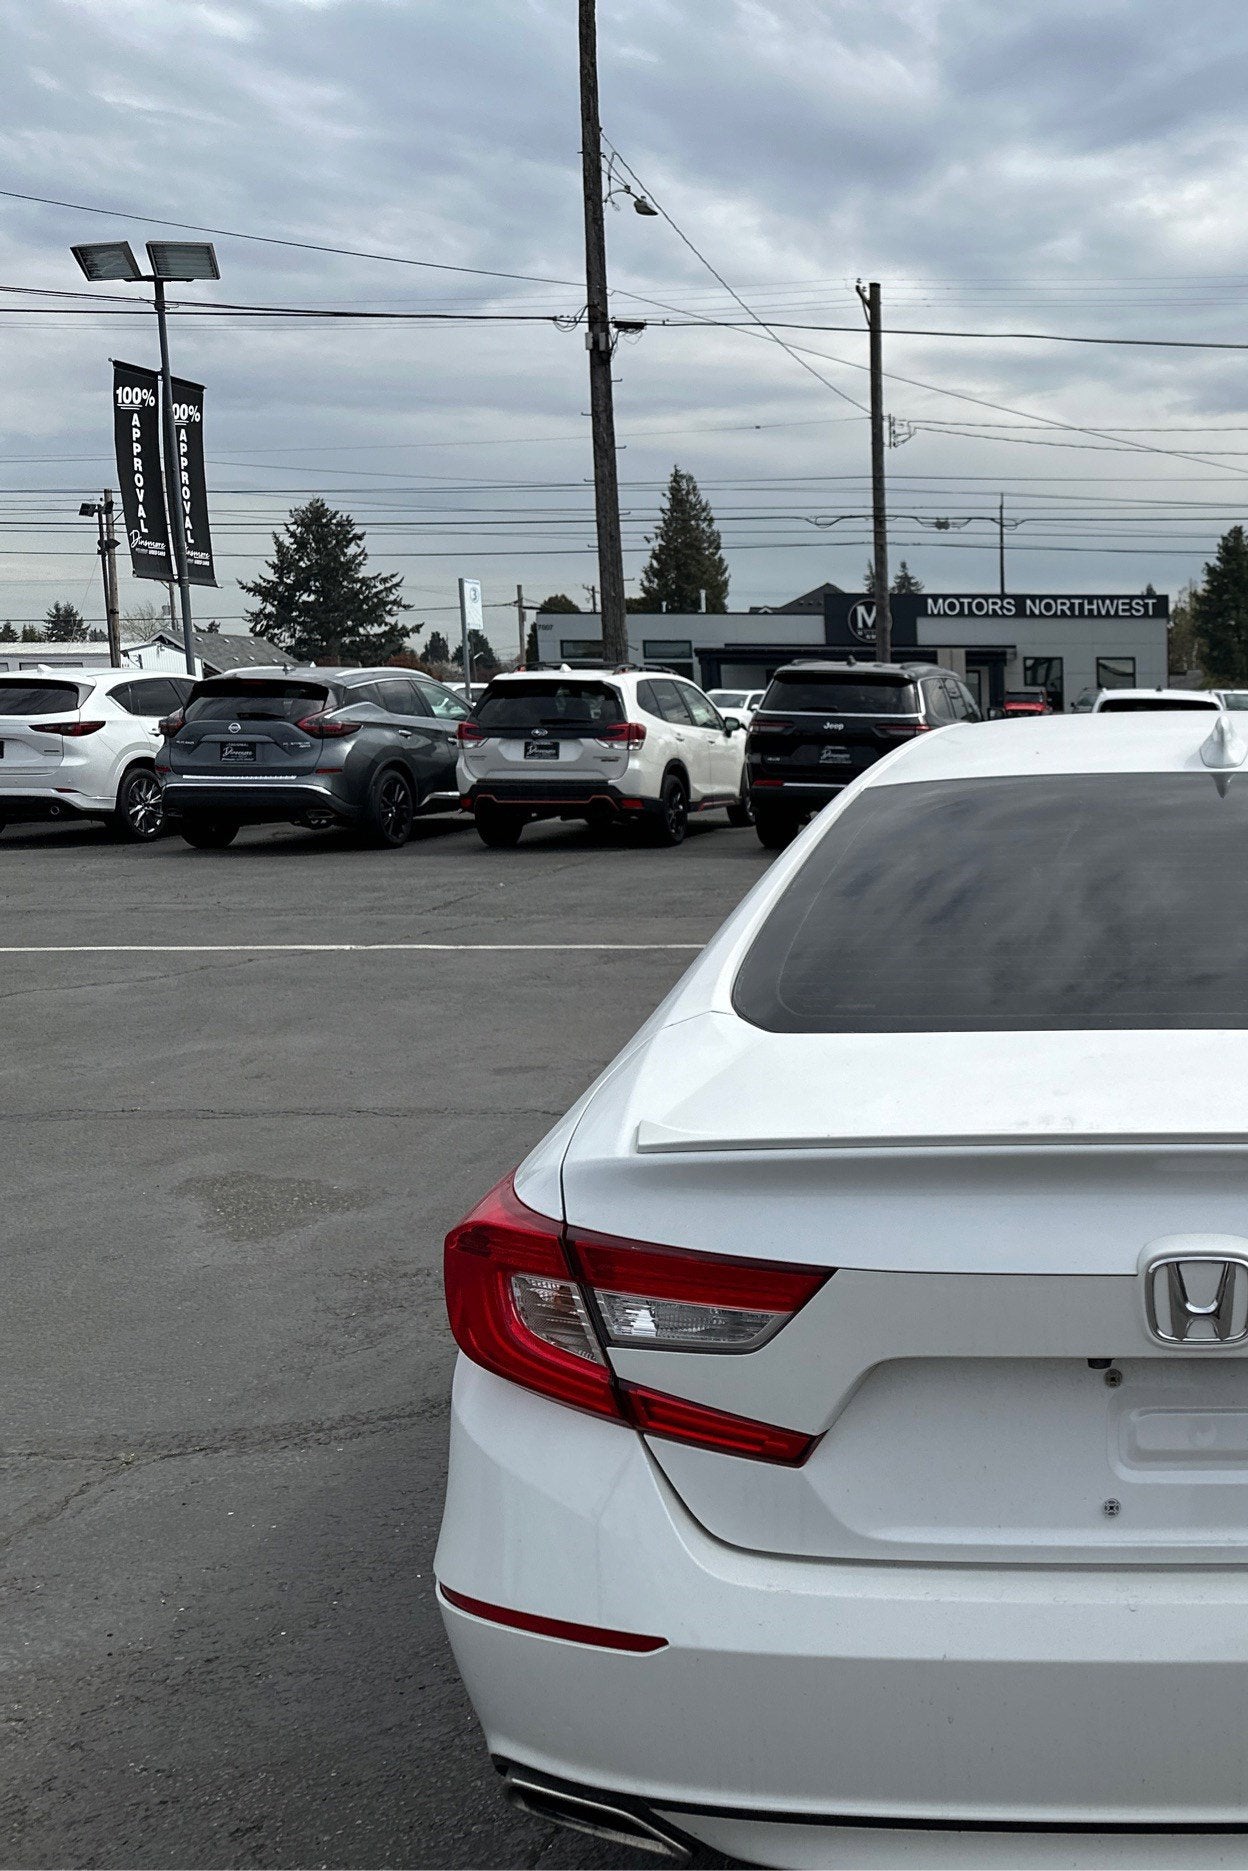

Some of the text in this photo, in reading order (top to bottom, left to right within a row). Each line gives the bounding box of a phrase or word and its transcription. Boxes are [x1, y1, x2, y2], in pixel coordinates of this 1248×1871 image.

[115, 386, 155, 407] 100%
[172, 403, 200, 423] 00%
[131, 413, 149, 533] APPROVAL
[179, 428, 195, 544] APPROVAL
[927, 597, 1157, 617] MOTORS NORTHWEST
[823, 722, 844, 731] Jeep
